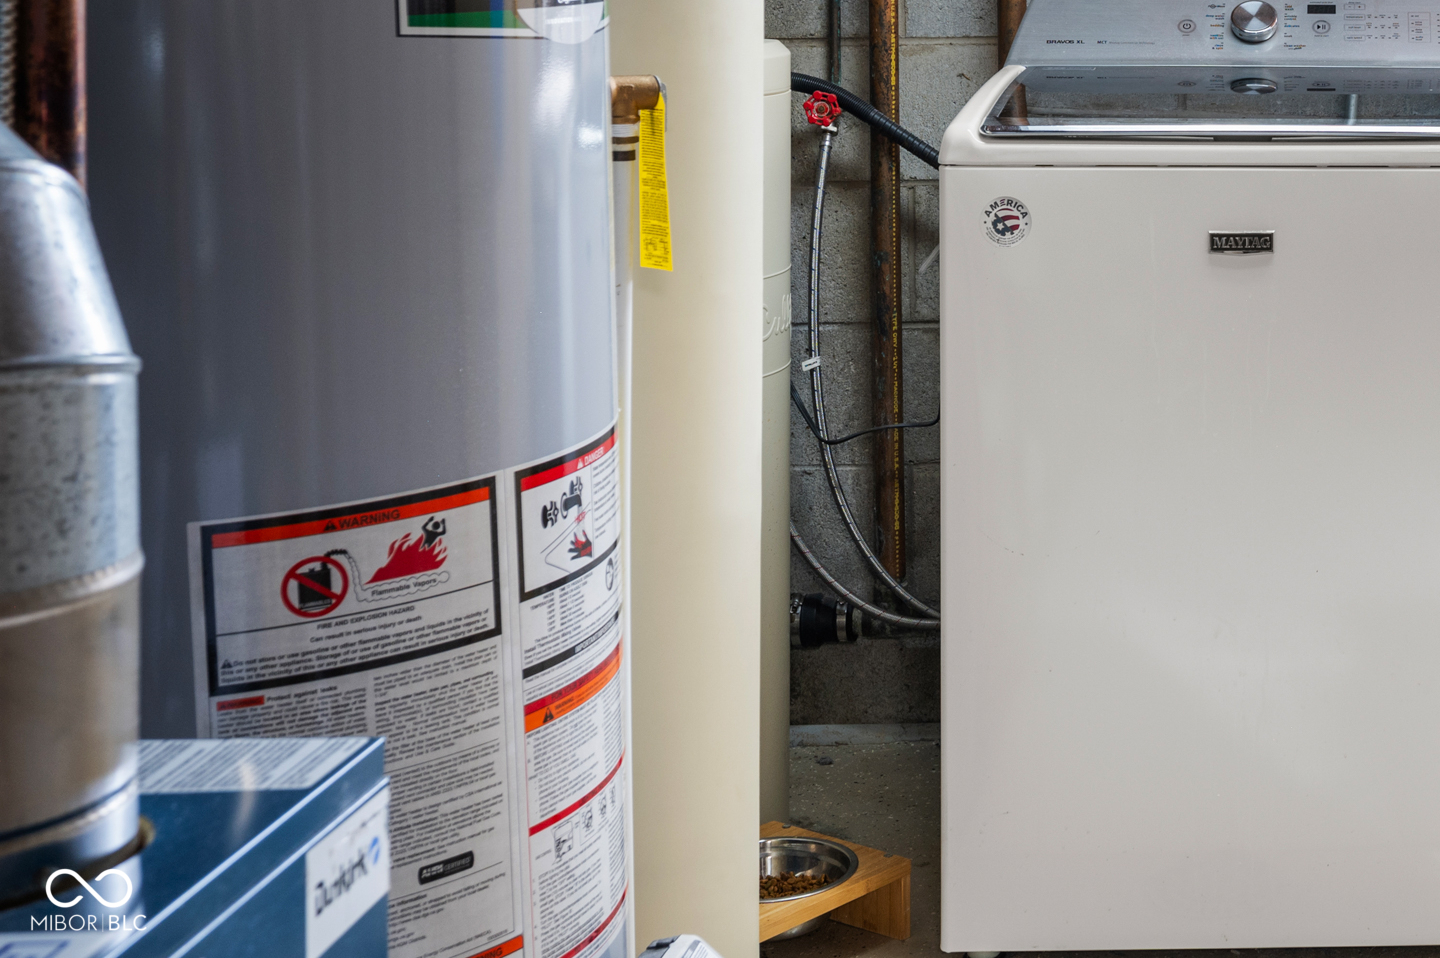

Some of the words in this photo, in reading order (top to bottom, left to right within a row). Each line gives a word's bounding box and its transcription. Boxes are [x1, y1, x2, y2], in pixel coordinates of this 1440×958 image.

[984, 198, 1028, 219] AMERICA
[1213, 236, 1271, 248] MAYTAG
[584, 446, 604, 465] DANGER
[339, 510, 400, 528] WARNING
[371, 585, 410, 596] Flammable
[413, 578, 437, 588] Vapors
[350, 612, 388, 624] EXPLOSION
[389, 606, 414, 616] HAZARD
[301, 647, 329, 658] gasoline
[340, 642, 356, 650] other
[358, 635, 390, 645] flammable
[392, 630, 412, 638] vapors
[426, 621, 445, 631] liquids
[464, 611, 482, 620] vicinity
[354, 626, 376, 634] serious
[378, 622, 395, 630] injury
[316, 652, 341, 663] Storage
[380, 638, 406, 649] gasoline
[432, 625, 461, 635] flammable
[462, 619, 480, 628] vapors
[269, 668, 293, 677] vicinity
[340, 654, 356, 663] other
[358, 651, 388, 661] appliance
[402, 642, 419, 650] result
[428, 636, 449, 644] serious
[294, 689, 318, 698] against
